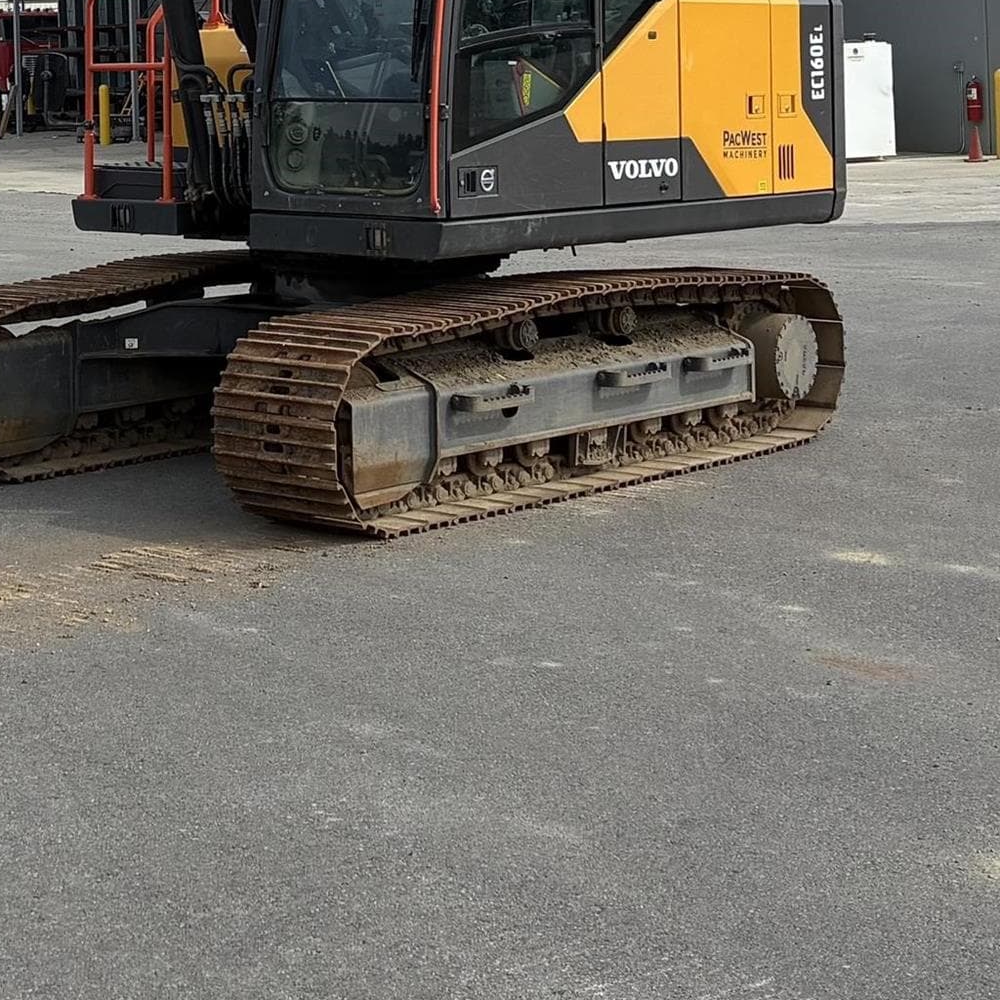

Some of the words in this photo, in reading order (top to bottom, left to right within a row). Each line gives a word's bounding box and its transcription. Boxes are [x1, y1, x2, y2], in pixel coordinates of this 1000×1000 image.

[810, 24, 825, 100] EC160EL
[723, 150, 767, 159] MACHINERY
[607, 157, 679, 180] VOLVO
